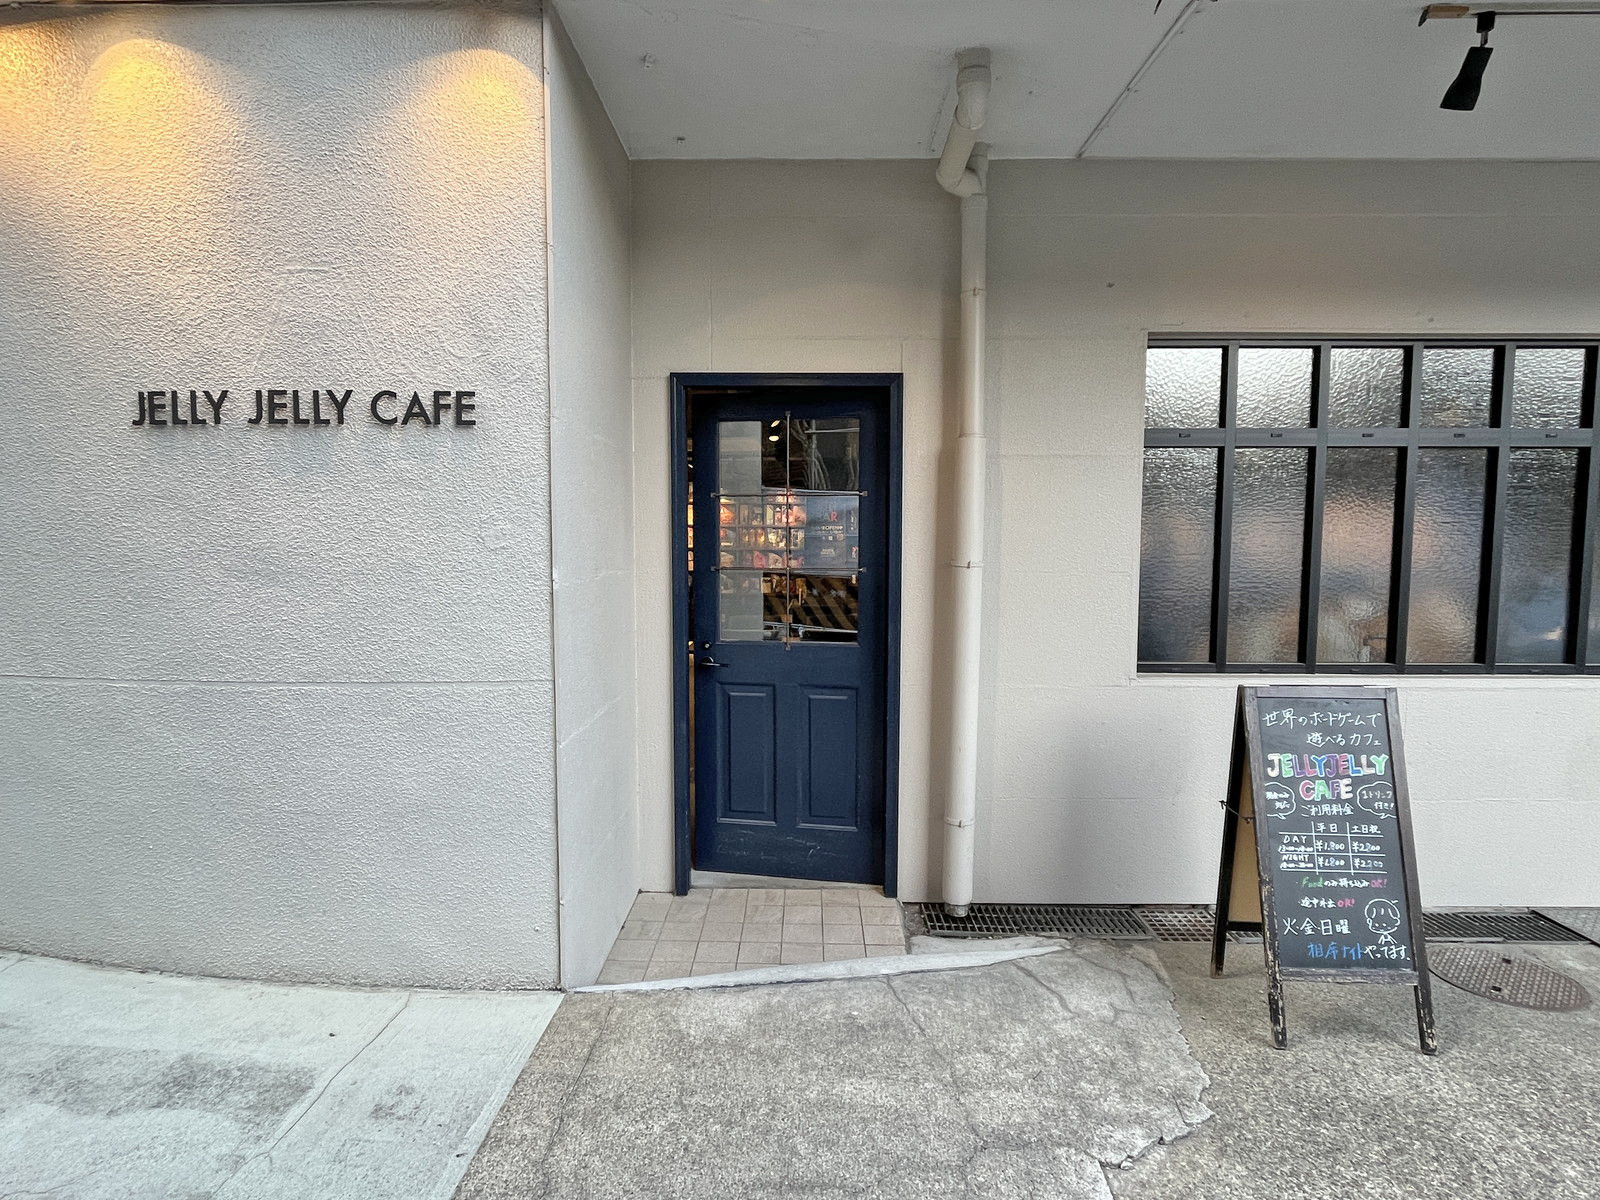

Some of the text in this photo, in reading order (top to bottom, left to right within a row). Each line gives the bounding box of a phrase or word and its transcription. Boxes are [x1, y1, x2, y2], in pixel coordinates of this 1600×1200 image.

[132, 389, 476, 426] JELLY JELLY CAFE
[1262, 707, 1382, 729] 世界のボードゲームで
[1299, 778, 1353, 801] CAFE
[1301, 803, 1354, 818] ご利用料金
[1316, 822, 1338, 833] 平日
[1283, 835, 1307, 844] DAY
[1282, 854, 1310, 862] NIGHT
